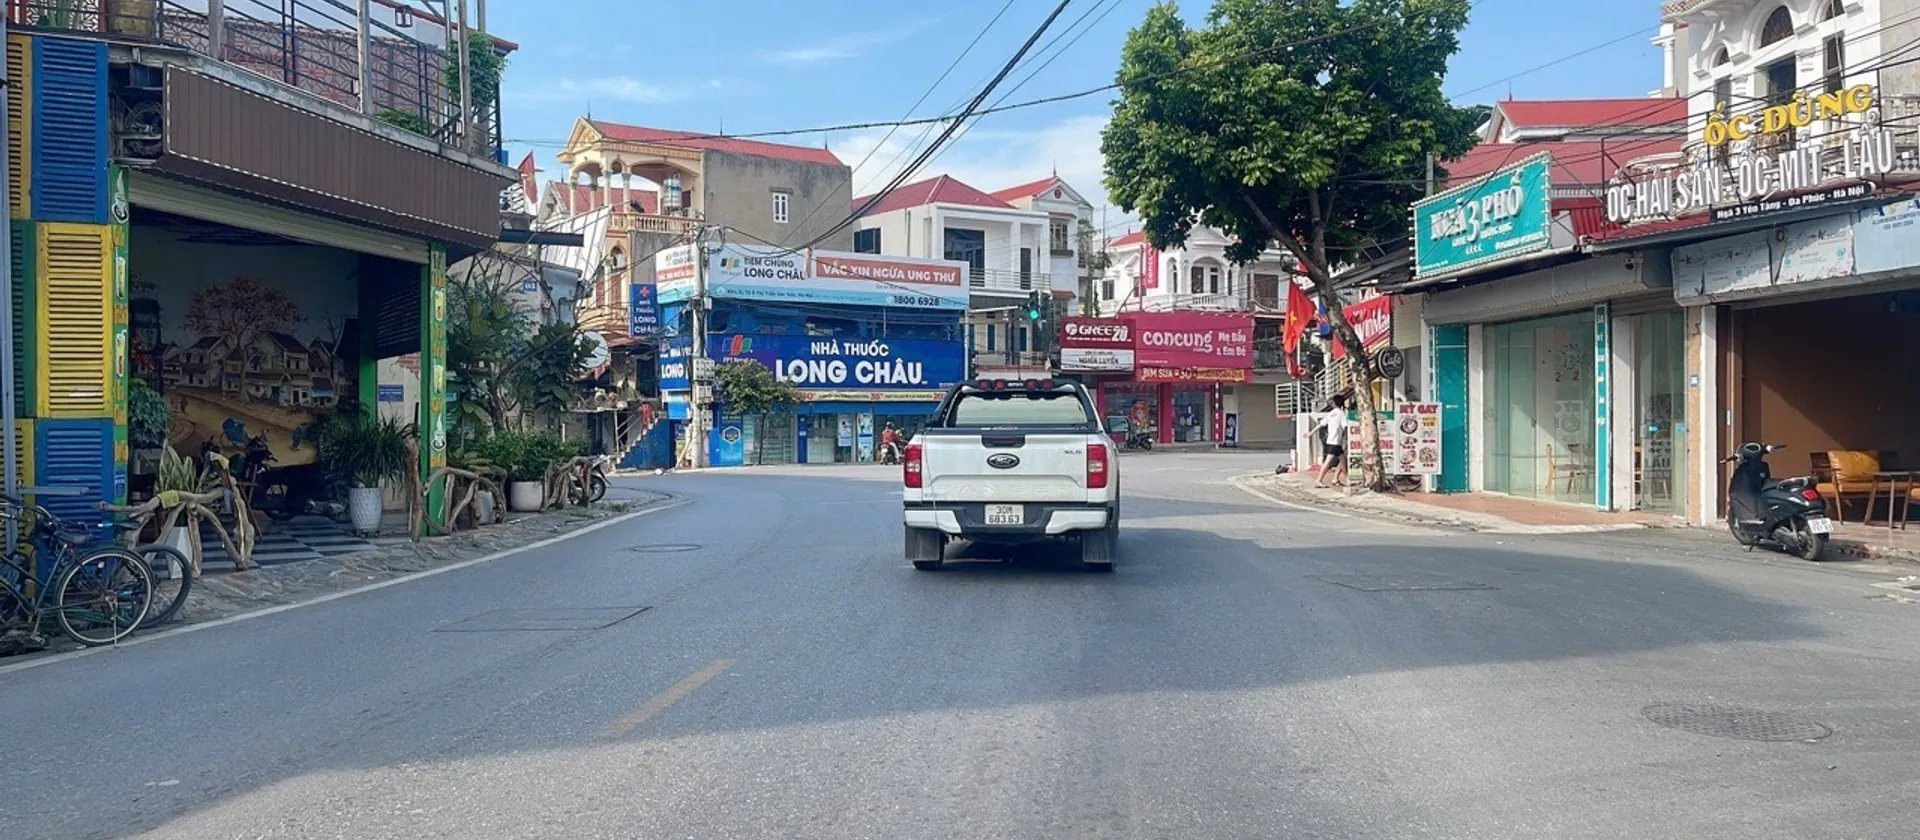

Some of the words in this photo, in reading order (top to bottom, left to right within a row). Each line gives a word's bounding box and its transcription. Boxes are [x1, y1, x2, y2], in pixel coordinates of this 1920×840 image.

[1703, 101, 1749, 146] ỐC
[1762, 83, 1872, 133] DŨNG
[1676, 157, 1721, 209] SẢN
[1843, 107, 1893, 178] LẨU
[1717, 208, 1734, 219] Ngã
[1735, 207, 1741, 216] 3
[1802, 192, 1825, 204] Phúc
[1833, 189, 1846, 199] Hà
[1848, 185, 1865, 196] Nội
[1467, 201, 1480, 241] 3
[744, 267, 774, 279] LONG
[872, 266, 905, 279] NGỪA
[908, 270, 931, 281] UNG
[933, 271, 956, 283] THƯ
[894, 296, 916, 306] 1800
[918, 296, 940, 306] 6928
[635, 316, 656, 324] LONG
[1079, 325, 1112, 336] GREE
[811, 339, 840, 356] NHÀ
[843, 339, 889, 357] THUỐC
[661, 363, 684, 379] LONG
[775, 359, 847, 384] LONG
[855, 357, 922, 384] CHÂU
